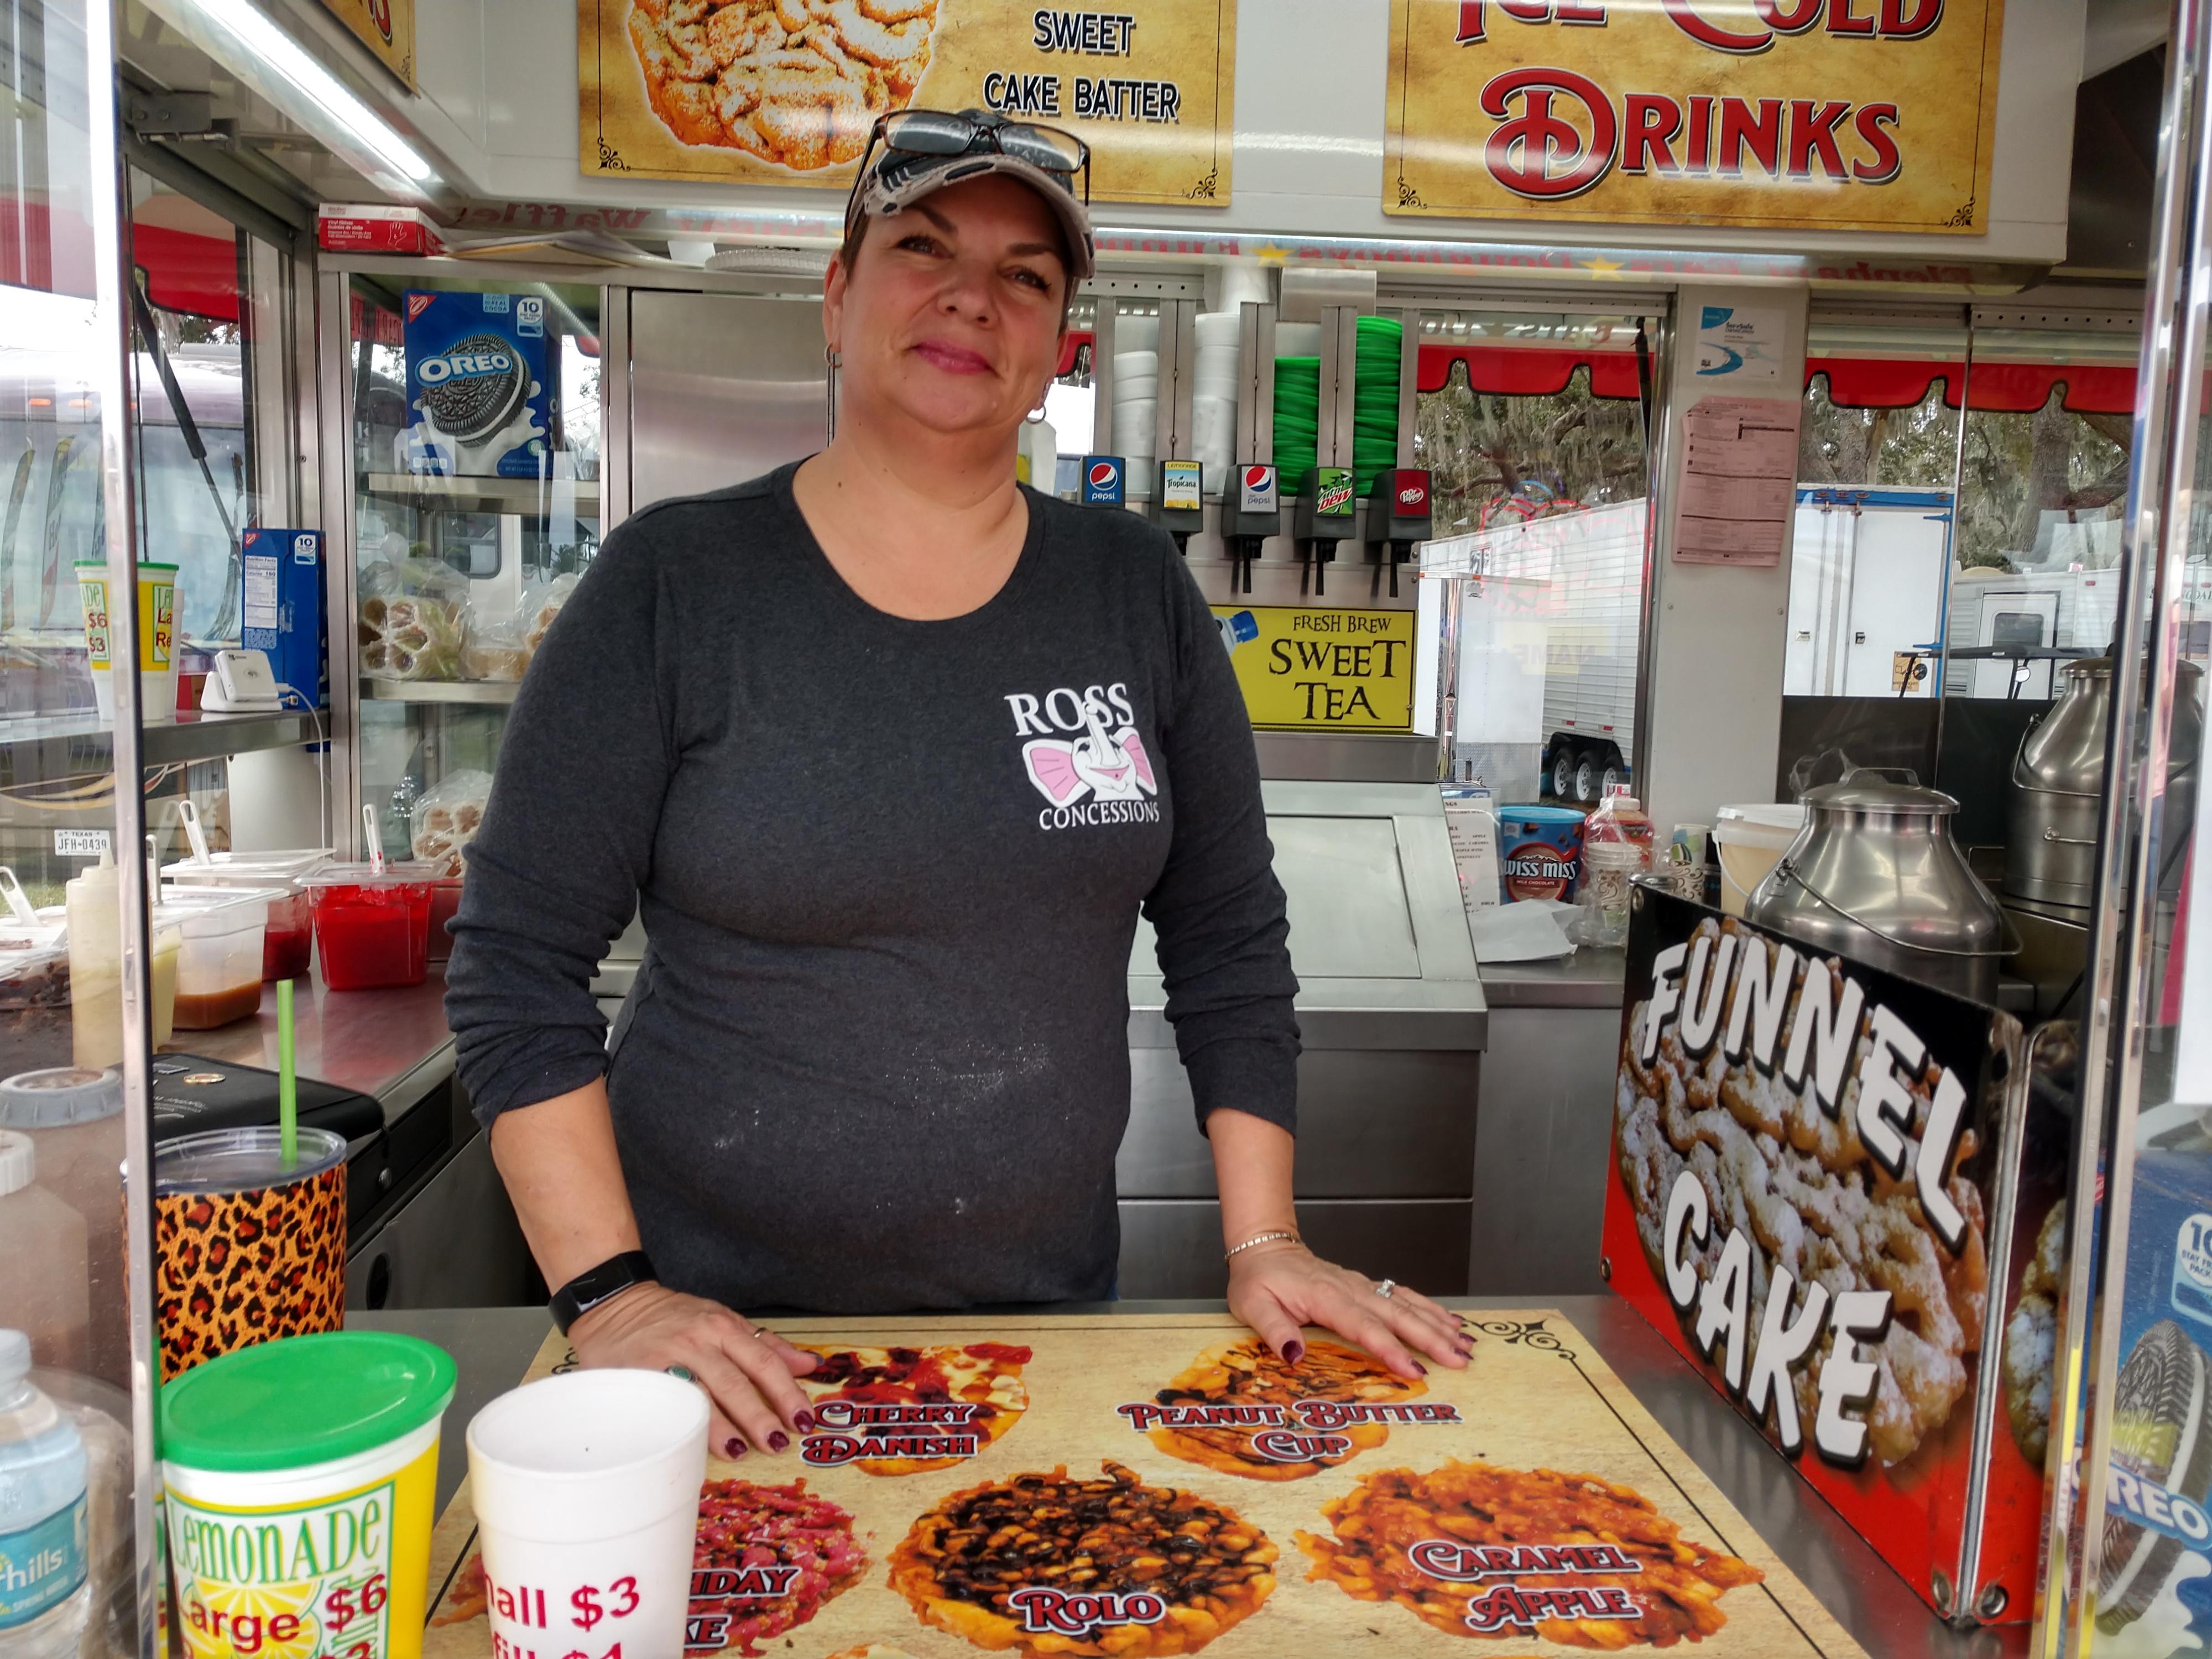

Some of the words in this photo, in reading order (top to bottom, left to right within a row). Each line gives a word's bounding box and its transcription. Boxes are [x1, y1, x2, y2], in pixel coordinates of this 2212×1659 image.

[1033, 9, 1135, 54] SWEET
[983, 71, 1059, 114] CAKE
[1074, 78, 1179, 119] BATTER
[1480, 67, 1901, 199] DRINKS
[522, 302, 539, 312] 10
[419, 354, 509, 382] OREO
[1092, 492, 1115, 500] pepsi
[1167, 478, 1196, 488] Tropicana
[299, 538, 312, 546] 10
[88, 612, 108, 629] $6
[1292, 614, 1342, 633] FRESH
[1347, 616, 1391, 634] BREW
[89, 637, 106, 653] $3
[1269, 638, 1406, 678] SWEET
[1004, 683, 1134, 736] ROSS
[1293, 682, 1381, 720] TEA
[1039, 801, 1160, 831] CONCESSIONS
[1642, 934, 1970, 1253] FUNNEL
[1662, 1169, 1893, 1462] CAKE
[811, 1400, 977, 1431] CHERRY
[1117, 1402, 1284, 1433] PEANUT
[1294, 1400, 1467, 1431] BUTTER
[800, 1434, 978, 1467] DANISH
[1253, 1432, 1353, 1464] CUP
[2106, 1464, 2210, 1541] REO
[1409, 1542, 1642, 1582] CARAMEL
[325, 1573, 387, 1634] $6
[571, 1575, 640, 1632] $3
[1009, 1587, 1167, 1635] ROLO
[1467, 1585, 1644, 1632] APPLE
